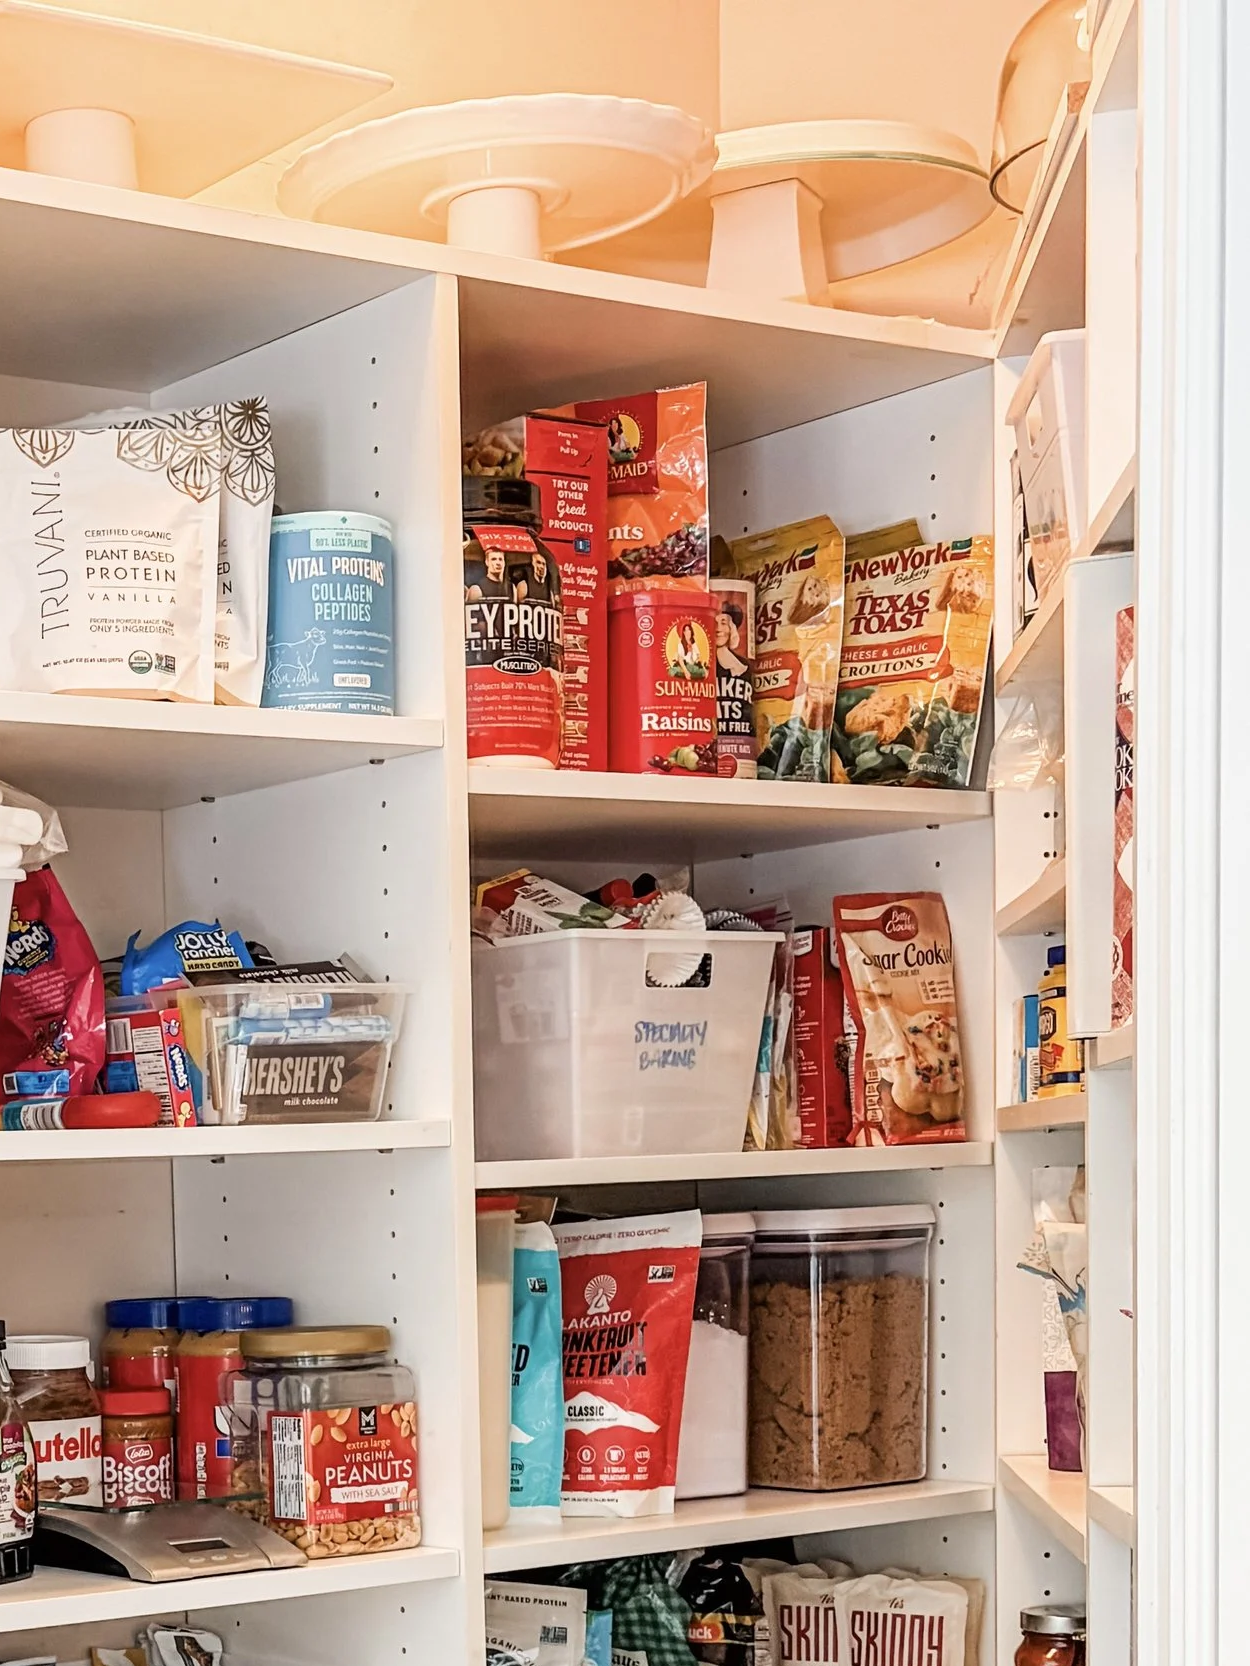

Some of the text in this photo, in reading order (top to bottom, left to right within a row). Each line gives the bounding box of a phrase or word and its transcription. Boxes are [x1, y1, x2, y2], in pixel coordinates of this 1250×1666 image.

[552, 479, 589, 492] TRY OUR
[558, 489, 584, 501] OTHER
[557, 499, 587, 517] Great
[84, 529, 172, 541] CERTIFIED ORGANIC
[549, 520, 594, 533] PRODUCTS
[480, 534, 502, 543] SIX
[31, 481, 70, 640] TRUVANI
[85, 549, 175, 564] PLANT BASED
[86, 567, 176, 582] PROTEIN
[287, 557, 387, 586] VITAL PROTEINS
[576, 565, 598, 578] simple
[87, 592, 177, 605] VANILLA
[311, 583, 373, 604] COLLAGEN
[855, 590, 930, 616] TEXAS
[315, 602, 371, 622] PEPTIDES
[89, 625, 175, 637] ONLY INGREDIENTS
[850, 610, 929, 636] TOAST
[892, 641, 928, 655] GARLIC
[839, 657, 924, 679] CROUTONS
[655, 680, 715, 699] SUN-MAID
[296, 702, 342, 712] SUPPLEMENT
[642, 713, 711, 733] Raisins
[891, 910, 912, 927] Betty
[176, 929, 228, 950] JOLLY
[183, 944, 236, 961] rancher
[212, 960, 239, 970] CANDY
[244, 1055, 346, 1096] HERSHEY'S
[284, 1097, 338, 1107] milk chocolate
[564, 1226, 671, 1244] ZERO CALORIE ZERO GLYCEMIC
[562, 1309, 632, 1330] LAKANTO
[567, 1404, 604, 1417] CLASSIC
[33, 1426, 102, 1463] utella
[346, 1438, 391, 1451] extra large
[344, 1450, 394, 1463] VIRGINIA
[103, 1455, 170, 1484] Biscoff
[325, 1459, 413, 1486] PEANUTS
[341, 1486, 399, 1500] WITH SEA SALT
[533, 1598, 568, 1608] PROTEIN
[779, 1604, 839, 1663] SKIN
